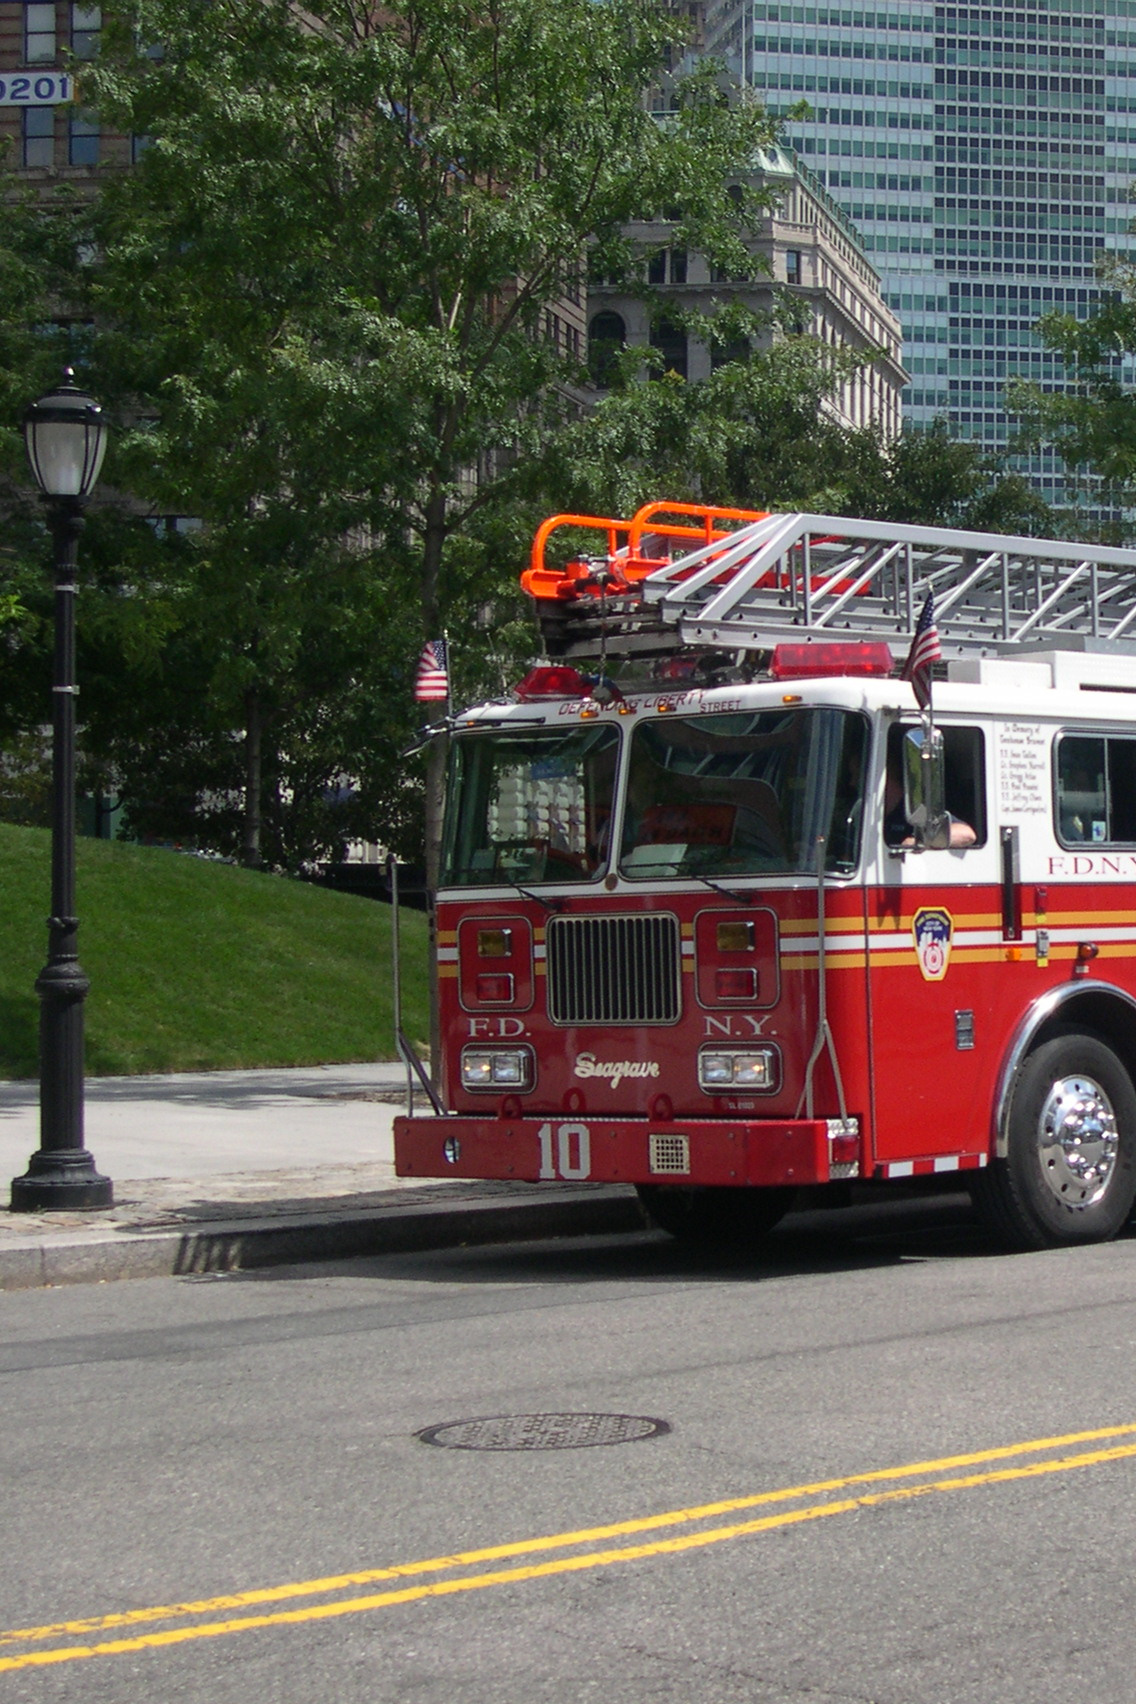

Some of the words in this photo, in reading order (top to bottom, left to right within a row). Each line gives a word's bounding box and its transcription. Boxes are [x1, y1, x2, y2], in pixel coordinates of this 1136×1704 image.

[644, 690, 706, 710] LIBERTY
[700, 700, 741, 713] STREET
[467, 1017, 532, 1037] F.D.
[703, 1015, 778, 1036] N.Y.
[574, 1051, 660, 1089] Seagrave
[537, 1123, 591, 1179] 10
